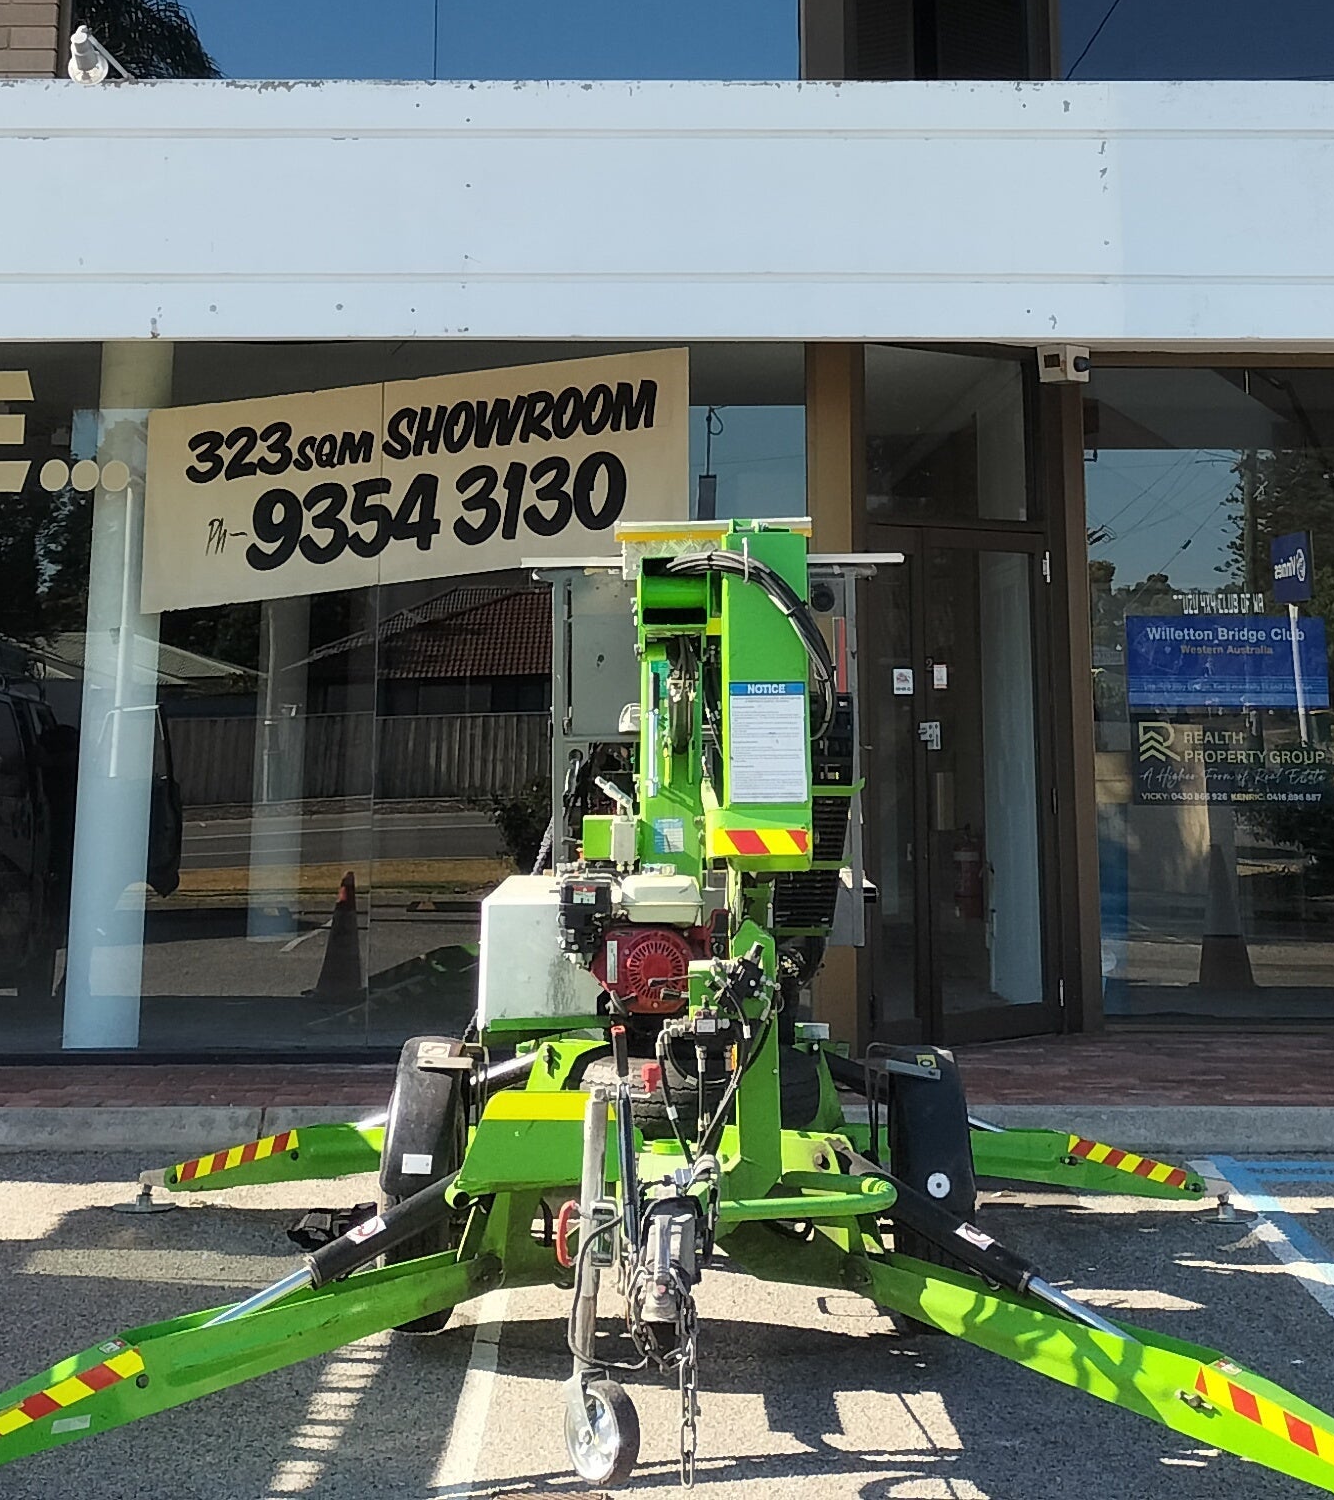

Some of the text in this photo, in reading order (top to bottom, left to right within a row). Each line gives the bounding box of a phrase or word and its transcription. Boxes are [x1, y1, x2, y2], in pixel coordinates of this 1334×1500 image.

[382, 379, 657, 460] SHOWROOM
[245, 473, 441, 571] 9354
[453, 451, 627, 546] 3130
[1146, 627, 1305, 645] Willetton Bridge Club
[1180, 645, 1273, 655] Western Australia
[747, 683, 786, 694] NOTICE
[1183, 731, 1244, 744] REALTH
[1184, 750, 1326, 764] PROPERTY GROUP
